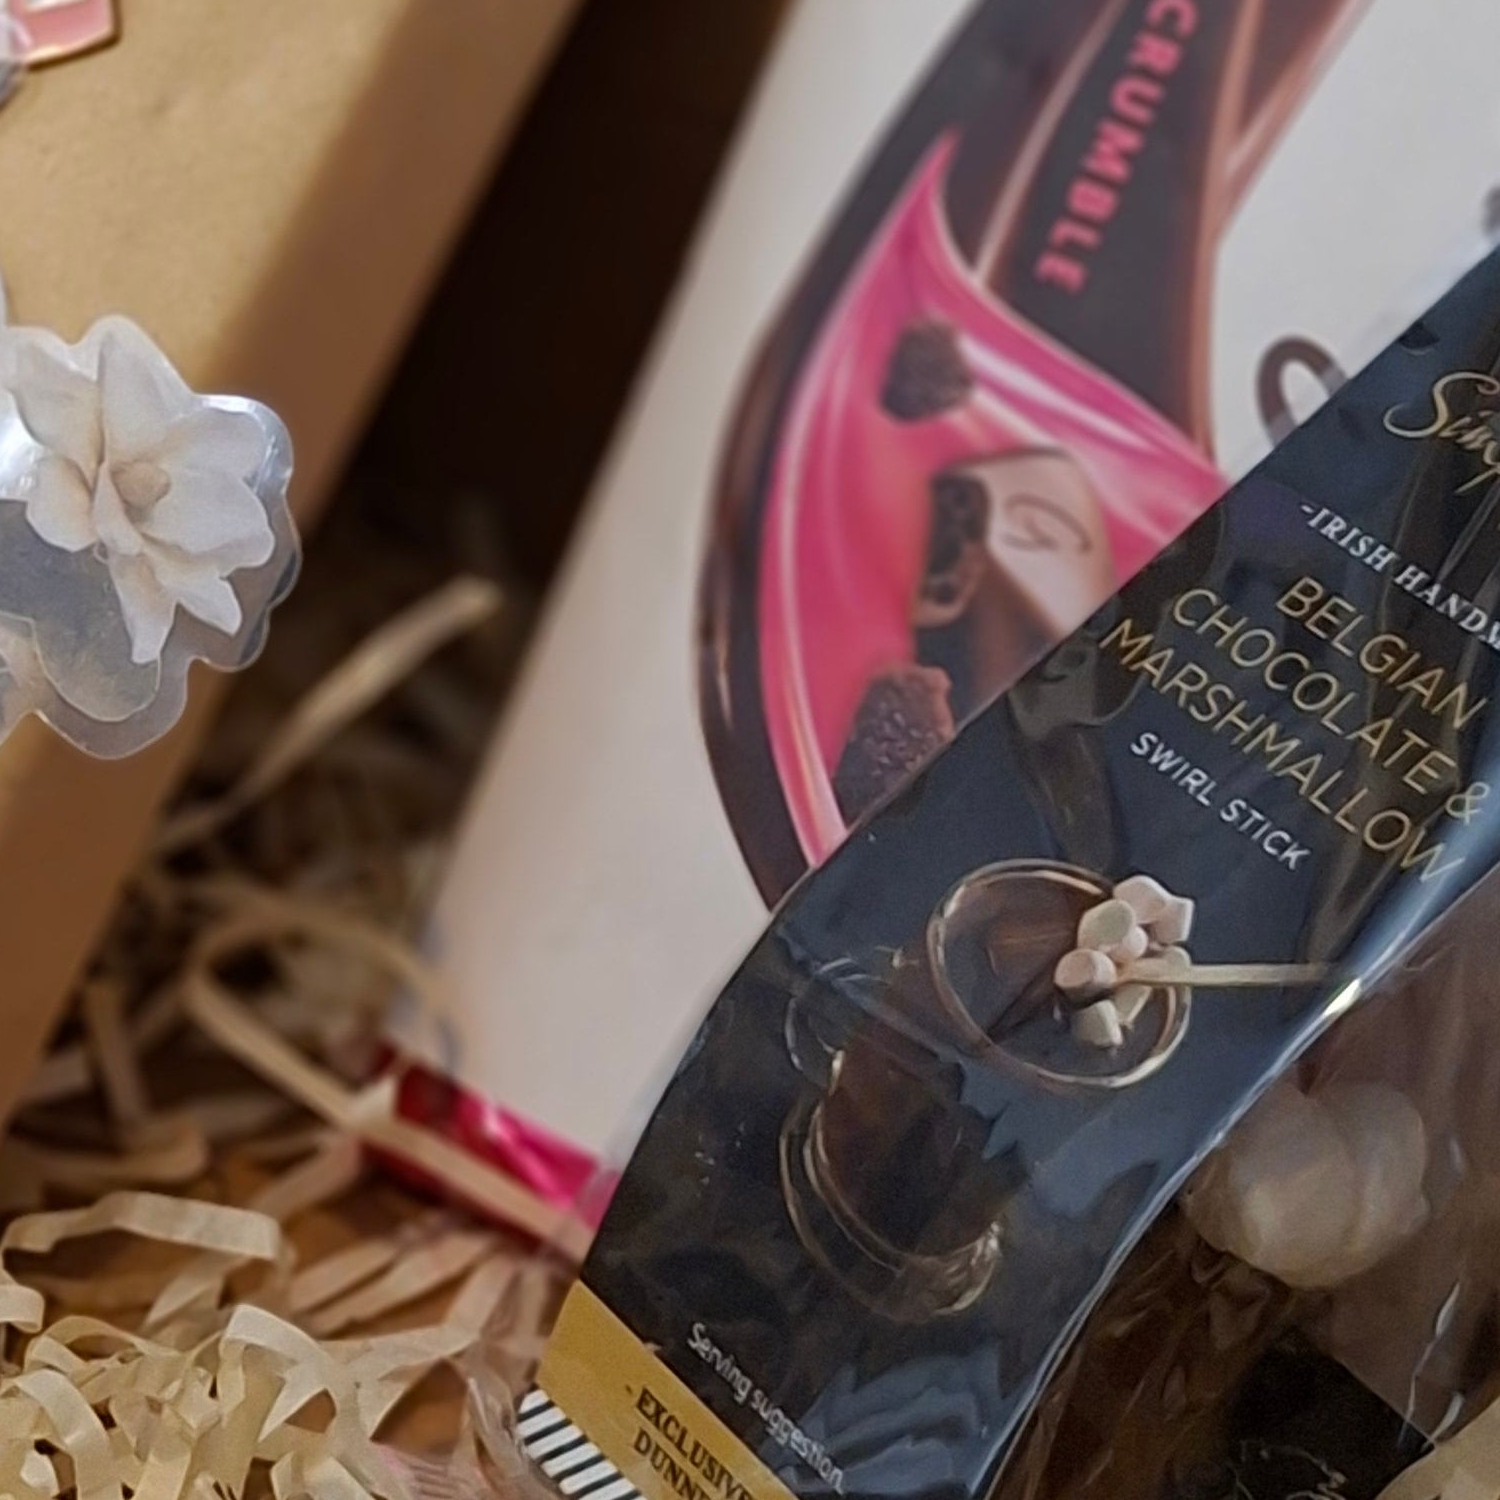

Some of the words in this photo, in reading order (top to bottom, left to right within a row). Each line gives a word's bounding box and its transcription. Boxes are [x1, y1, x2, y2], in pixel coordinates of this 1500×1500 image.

[1172, 588, 1457, 796] CHOCOLATE
[1446, 780, 1491, 826] &
[1276, 575, 1488, 730] BELGIAN
[1100, 617, 1466, 884] MARSHMALLOW
[1130, 731, 1217, 809] SWIRL
[1219, 800, 1311, 871] STICK
[686, 1321, 752, 1404] Serving
[751, 1387, 846, 1497] suggestion
